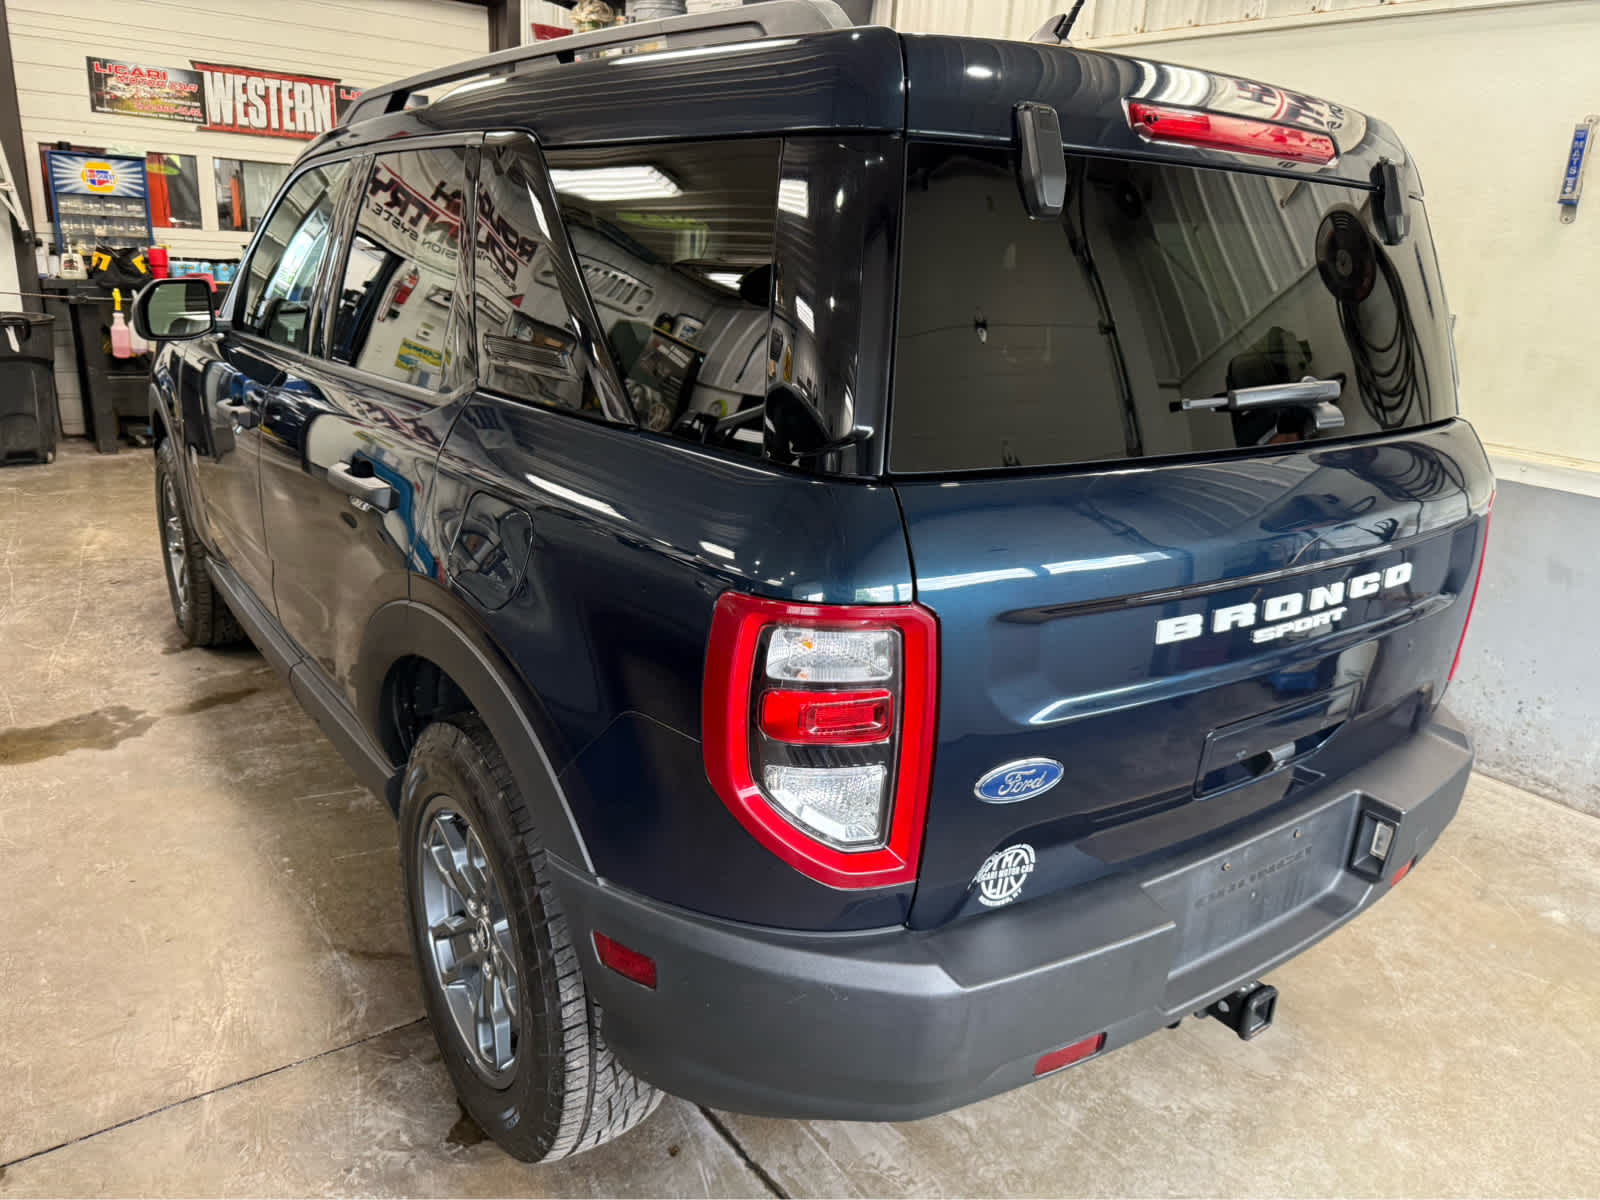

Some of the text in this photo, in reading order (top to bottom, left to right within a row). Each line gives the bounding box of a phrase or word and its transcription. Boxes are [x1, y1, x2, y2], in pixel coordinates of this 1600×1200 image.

[93, 61, 167, 81] LICARI
[203, 71, 333, 134] WESTERN
[1155, 562, 1412, 645] BRONCO
[1252, 607, 1347, 644] SPORT
[998, 769, 1047, 795] Ford
